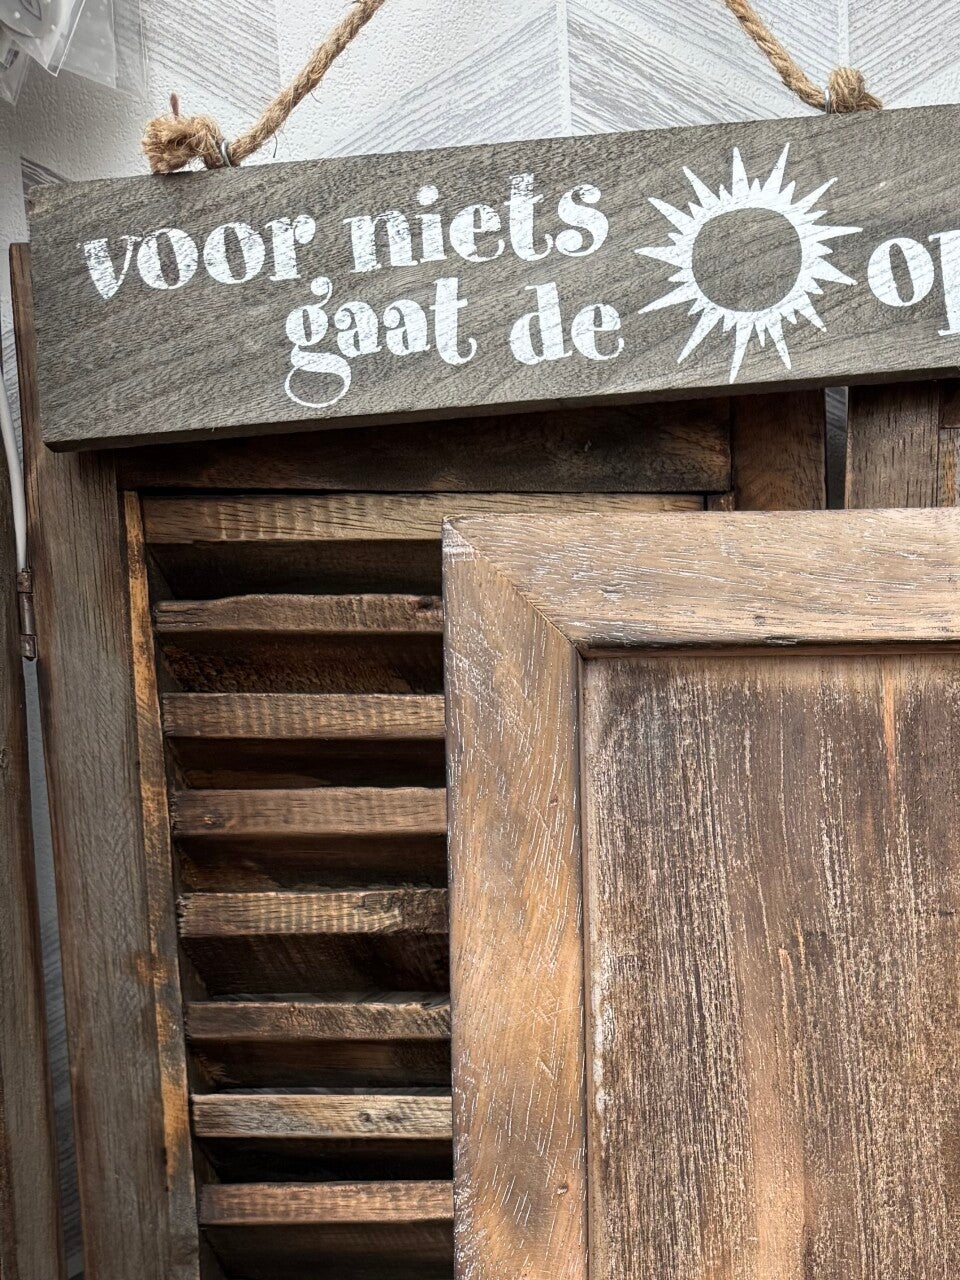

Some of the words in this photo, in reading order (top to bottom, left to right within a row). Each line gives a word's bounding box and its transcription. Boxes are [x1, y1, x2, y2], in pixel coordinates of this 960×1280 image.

[79, 215, 315, 300] voor
[343, 173, 609, 273] niets
[285, 276, 477, 407] gaat
[509, 281, 625, 366] de
